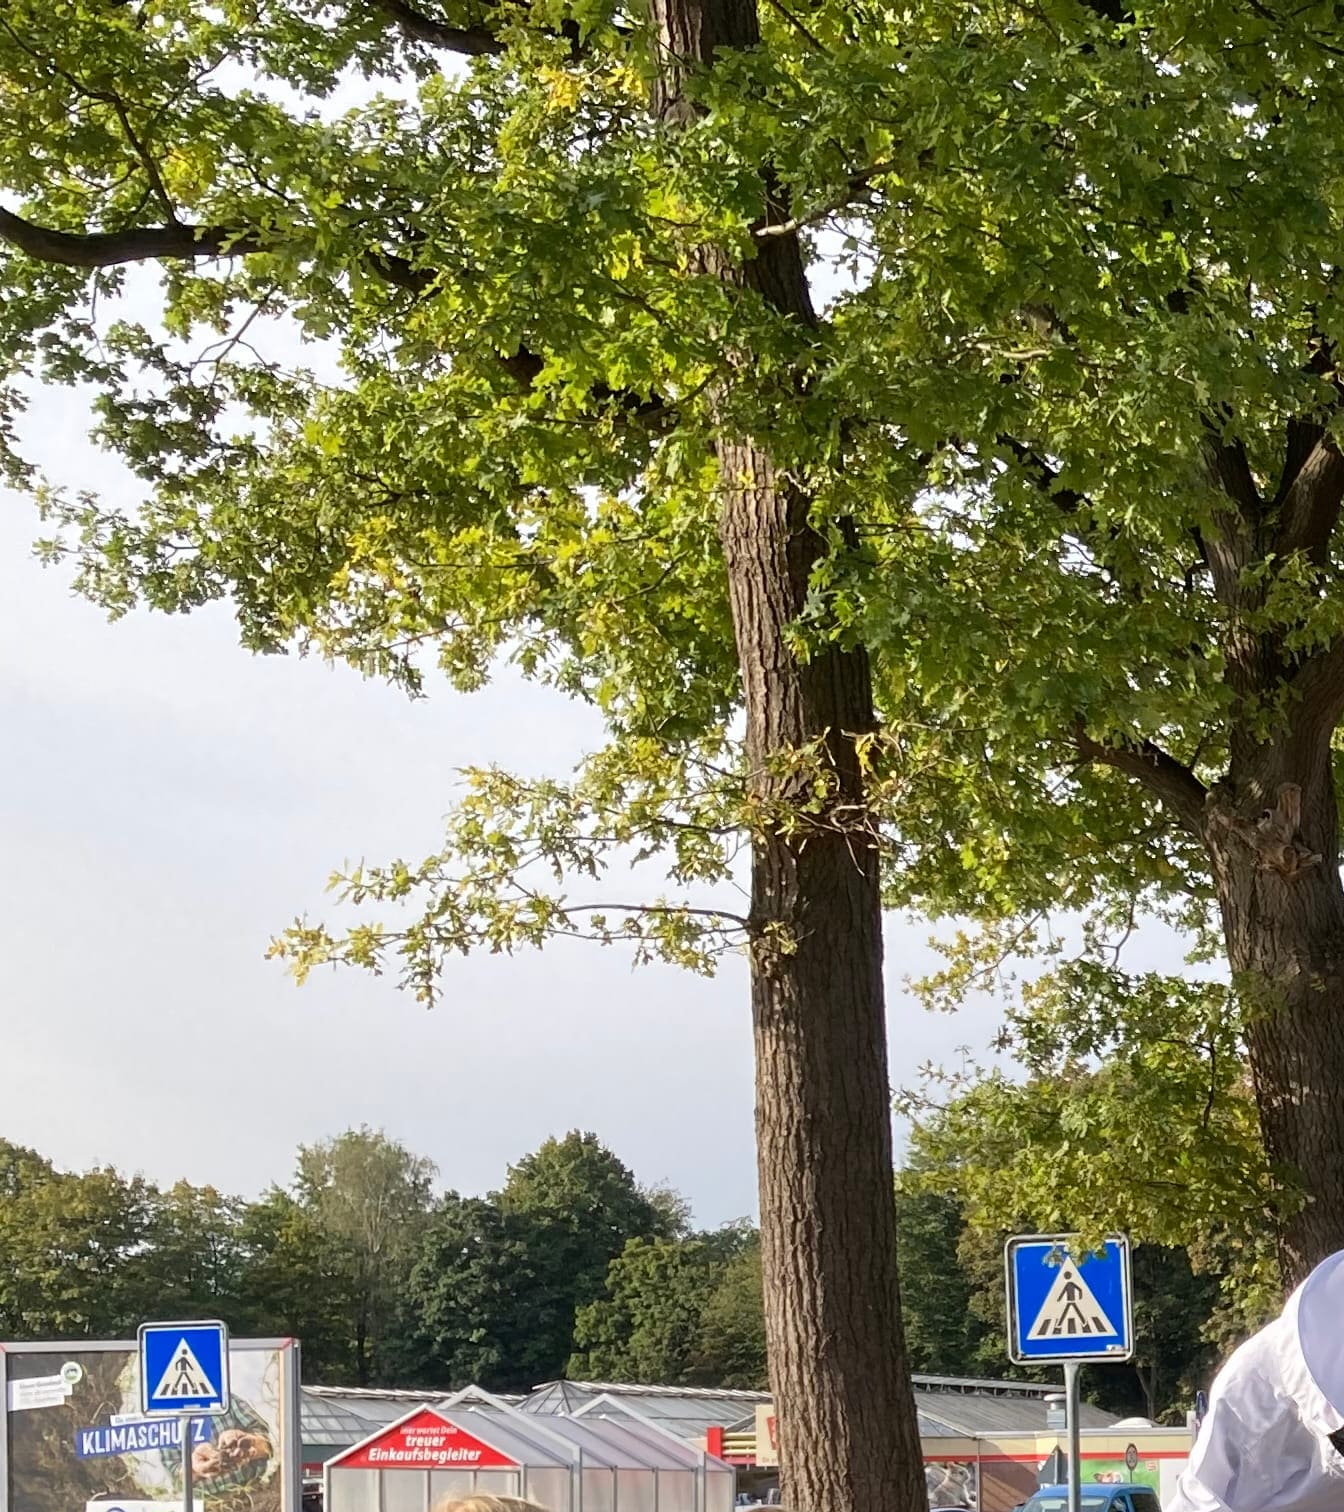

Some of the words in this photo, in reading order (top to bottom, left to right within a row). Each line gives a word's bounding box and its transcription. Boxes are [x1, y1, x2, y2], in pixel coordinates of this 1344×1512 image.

[82, 1418, 205, 1455] KLIMASCHUZ
[405, 1435, 447, 1447] treuer
[368, 1448, 482, 1464] Einkaufsbegleiter
